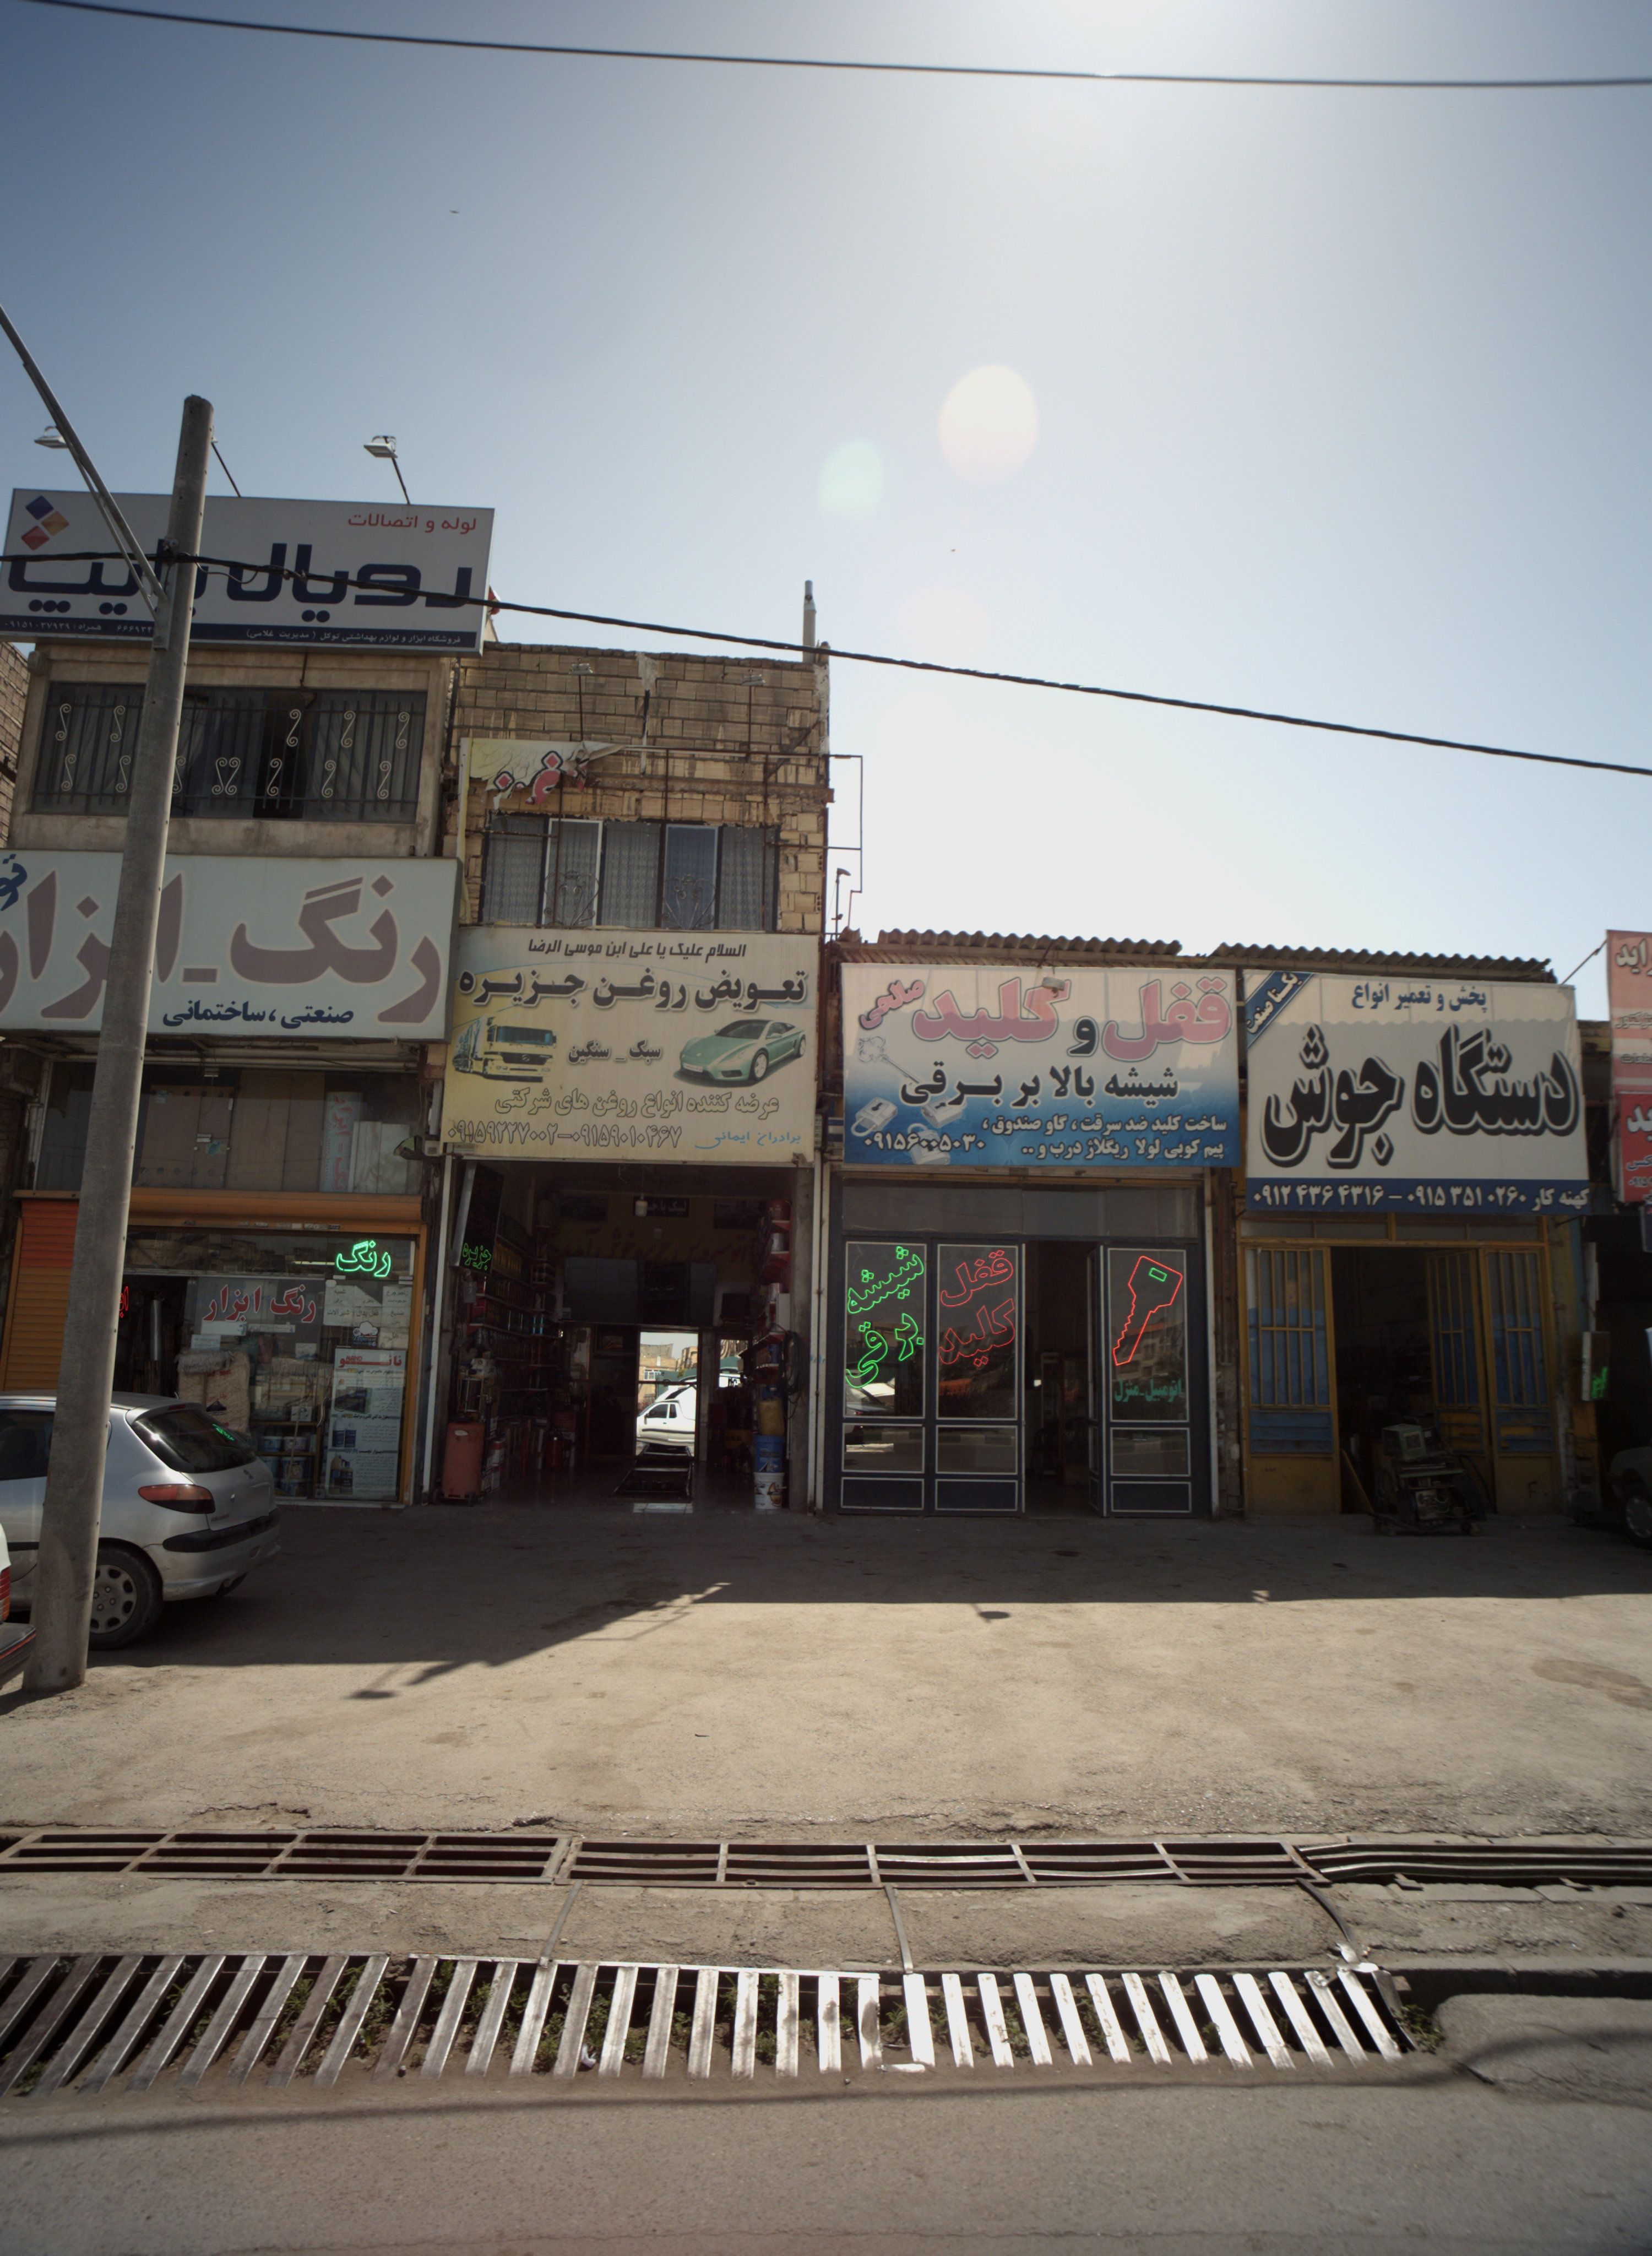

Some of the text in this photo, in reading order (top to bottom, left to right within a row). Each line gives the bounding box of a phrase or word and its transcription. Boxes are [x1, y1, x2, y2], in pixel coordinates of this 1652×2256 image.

[348, 513, 476, 534] لوله و اتصالات
[8, 538, 209, 617] ایپ
[341, 633, 377, 642] بهداشتی
[379, 634, 399, 643] لوازم
[408, 634, 426, 644] ابزار
[428, 634, 461, 644] فروشگاه
[230, 874, 441, 1023] رنگ
[528, 938, 747, 963] السلام علیک یا علی ابن موسی الرضا
[459, 968, 807, 1010] تعویض روغن جزیره
[1352, 983, 1487, 1012] پخش و تعمیر انواع
[162, 1000, 264, 1027] ساختمانی
[859, 978, 926, 1029] صالحی
[912, 976, 1232, 1061] قفل و کلید
[1246, 1000, 1274, 1034] صنعت
[568, 1039, 610, 1064] سنگین
[629, 1039, 662, 1064] سبک
[900, 1061, 1179, 1108] شیشه بالا بر برقی
[494, 1087, 780, 1120] عرضه کننده انواع روغن های شرکتی
[1262, 1024, 1581, 1169] دستگاه جوش
[1045, 1114, 1067, 1135] گاو
[1124, 1114, 1148, 1131] ضد
[1151, 1115, 1181, 1134] کلید
[1184, 1115, 1227, 1132] ساخت
[694, 1130, 801, 1150] برادران ایمانی
[864, 1131, 986, 1152] ۰۹۱۵۶۰۰۵۰۳۰
[1050, 1141, 1082, 1159] درب
[1085, 1138, 1129, 1159] ریگلاژ
[1135, 1138, 1160, 1159] لولا
[1164, 1140, 1200, 1158] کوبی
[1204, 1142, 1224, 1159] پیم
[1037, 1144, 1047, 1159] و
[1253, 1184, 1292, 1206] ۰۹۱۲
[1296, 1184, 1334, 1206] ۴۳۶
[1338, 1184, 1384, 1207] ۴۳۱۶
[1407, 1185, 1446, 1207] ۰۹۱۵
[1450, 1185, 1482, 1206] ۳۵۱
[1487, 1185, 1527, 1207] ۰۲۶۰
[1532, 1188, 1555, 1211] کار
[1558, 1188, 1590, 1210] کهنه
[335, 1239, 393, 1278] رنگ
[463, 1242, 492, 1271] جزیره
[847, 1245, 925, 1315] شیشه
[939, 1249, 1013, 1308] قفل
[202, 1284, 316, 1323] رنگ ابزار
[937, 1298, 1017, 1367] کلید
[845, 1313, 925, 1389] برقی
